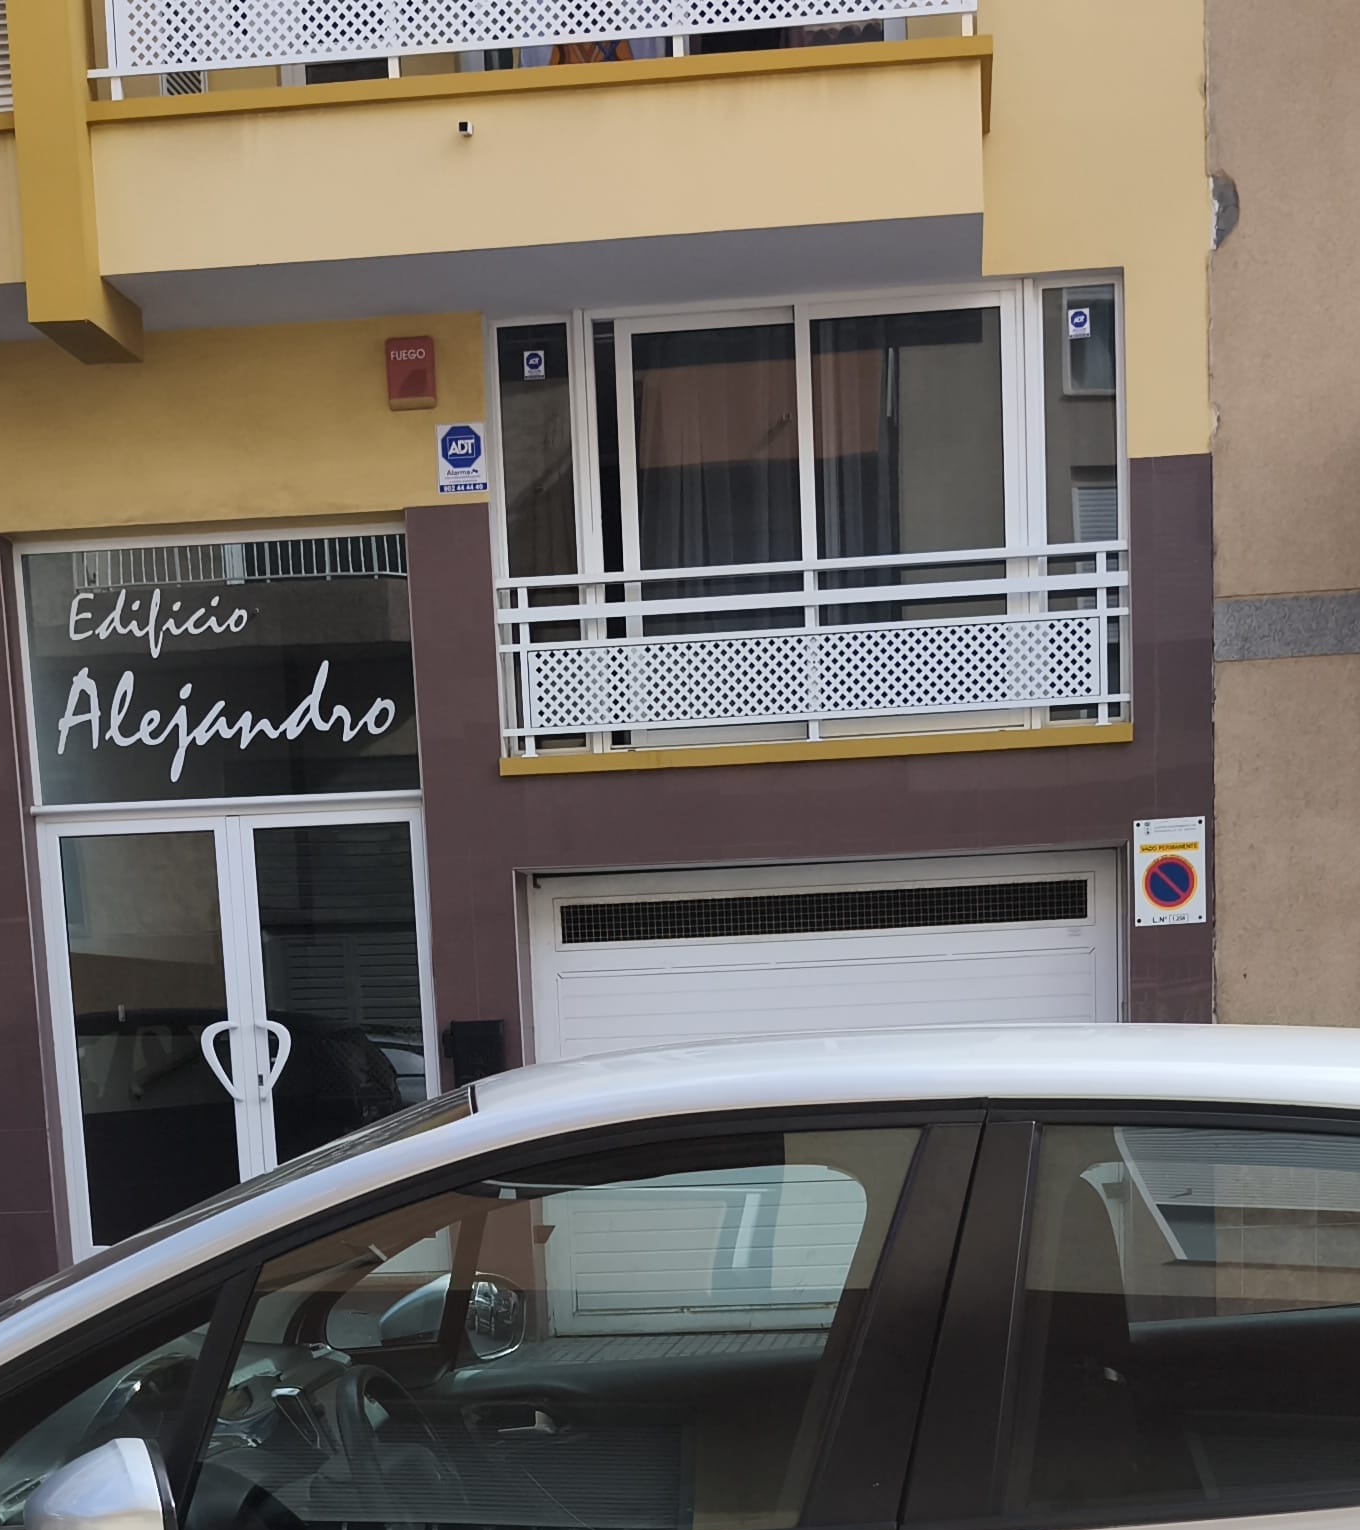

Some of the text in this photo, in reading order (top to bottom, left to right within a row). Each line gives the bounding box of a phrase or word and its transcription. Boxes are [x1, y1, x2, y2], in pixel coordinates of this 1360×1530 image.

[390, 348, 426, 361] FUEGO
[448, 440, 475, 455] ADT
[68, 588, 248, 659] Edificio
[58, 660, 396, 783] Alejandro
